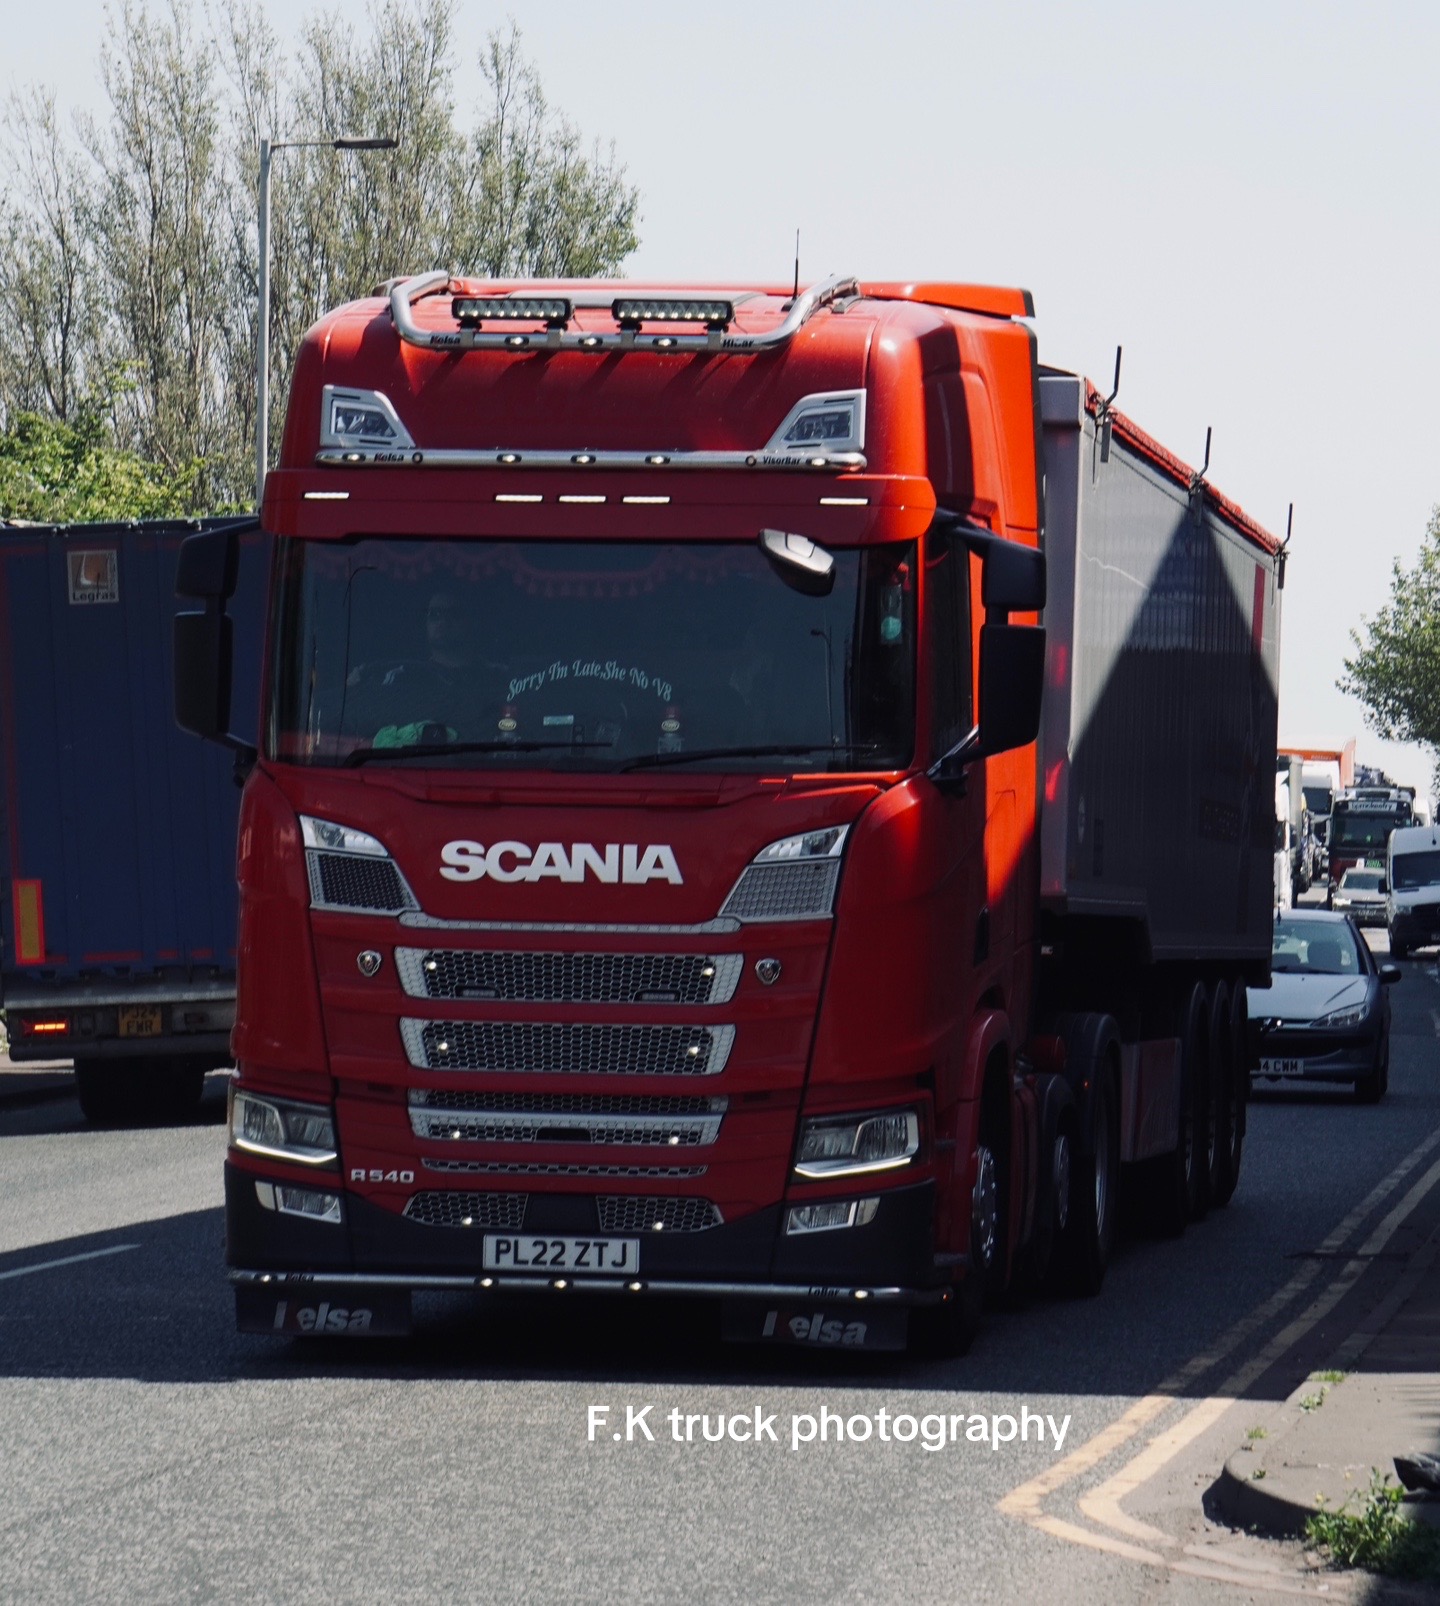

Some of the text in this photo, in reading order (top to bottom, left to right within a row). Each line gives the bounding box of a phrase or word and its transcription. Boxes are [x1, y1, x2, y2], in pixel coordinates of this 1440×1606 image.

[72, 591, 116, 603] Legras
[506, 668, 546, 702] Sorry
[629, 667, 649, 690] No
[652, 677, 672, 702] V8
[439, 840, 684, 885] SCANIA
[495, 1238, 628, 1268] PL22 ZTJ
